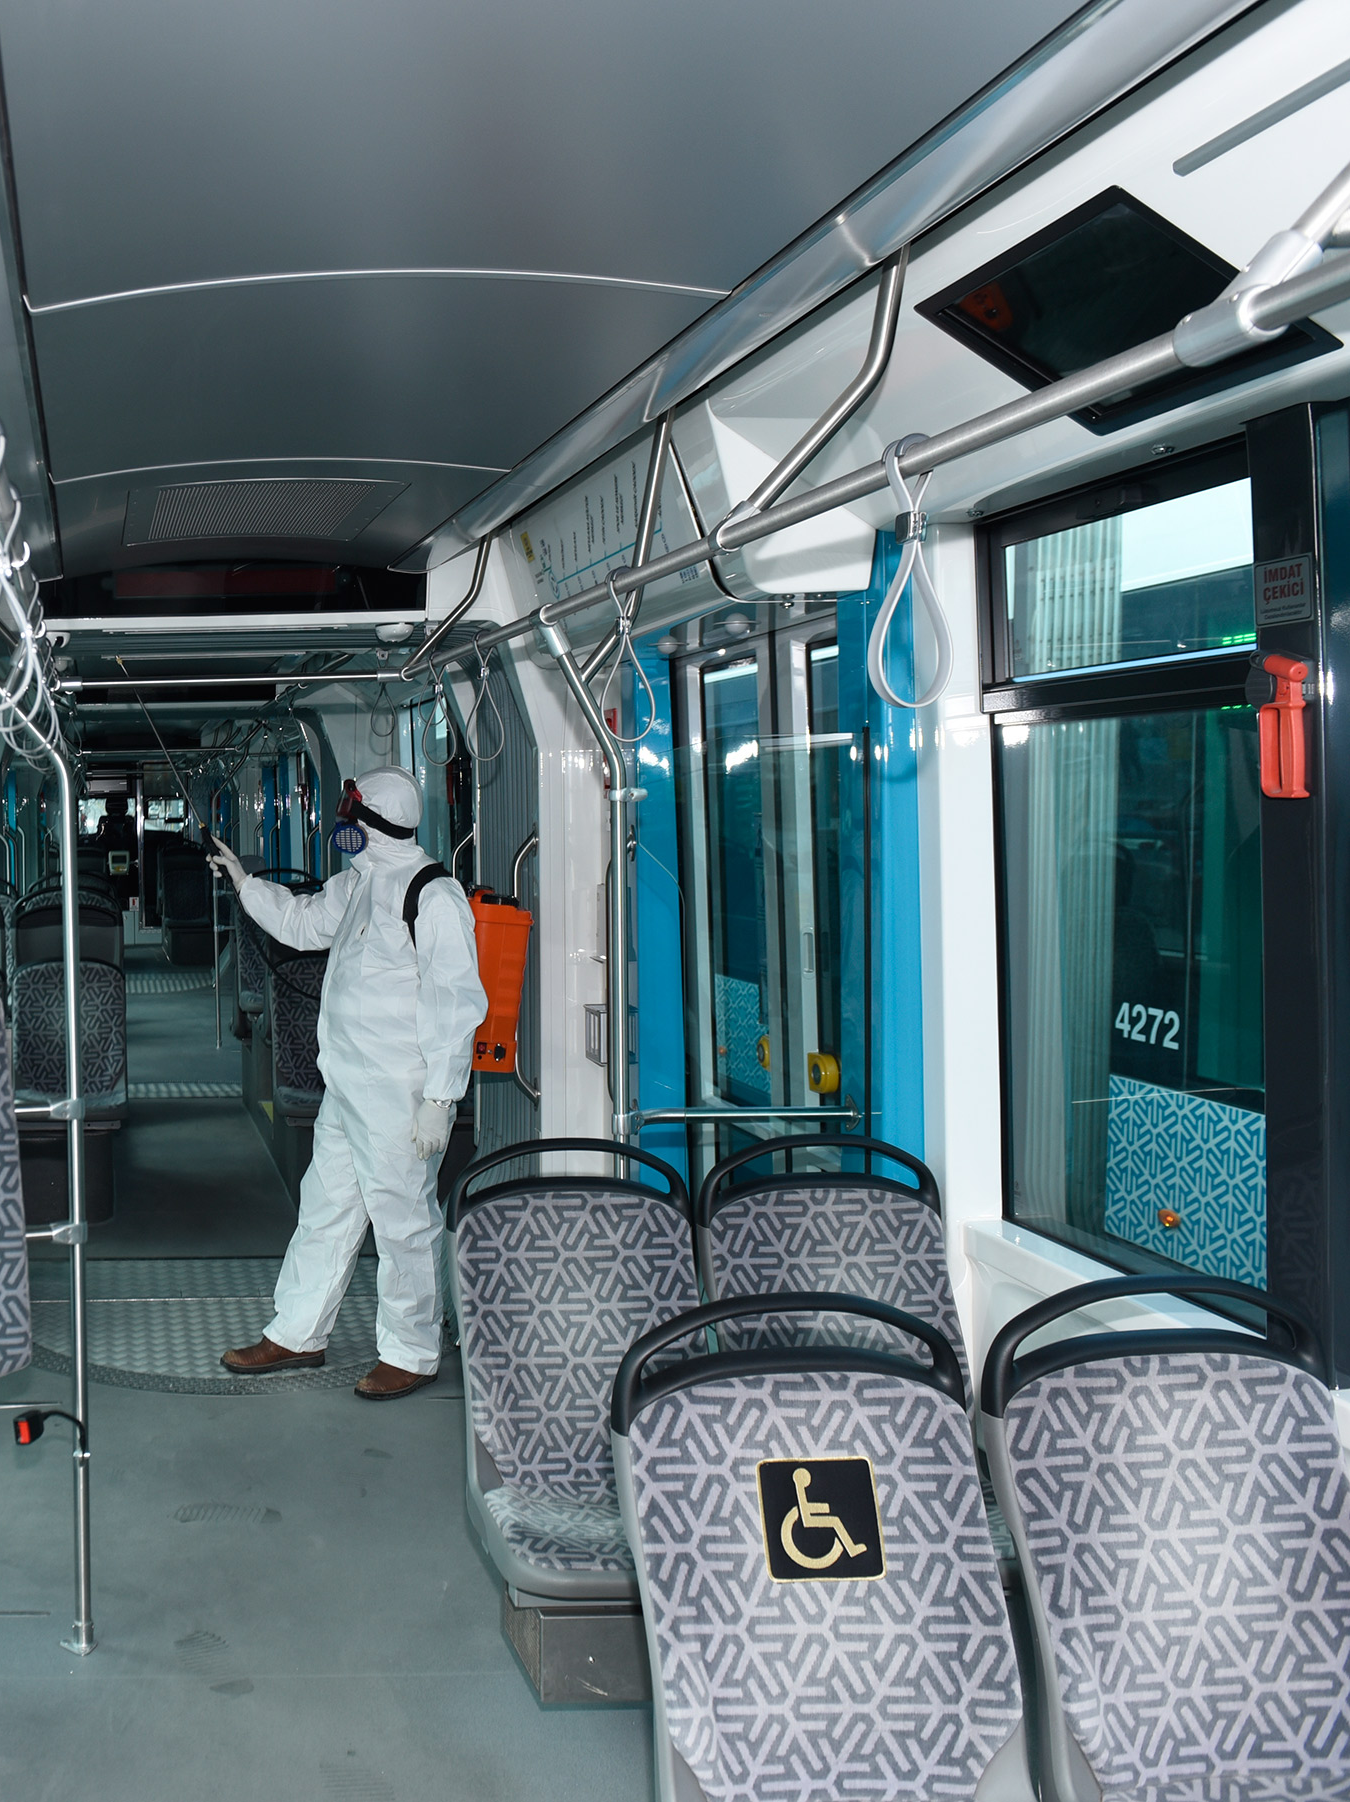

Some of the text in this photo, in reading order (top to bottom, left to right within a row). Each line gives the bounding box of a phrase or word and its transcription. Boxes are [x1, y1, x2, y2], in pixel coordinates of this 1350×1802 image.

[1263, 563, 1303, 584] İMDAT
[1263, 578, 1305, 605] ÇEKİCİ
[1115, 1002, 1180, 1051] 4272
